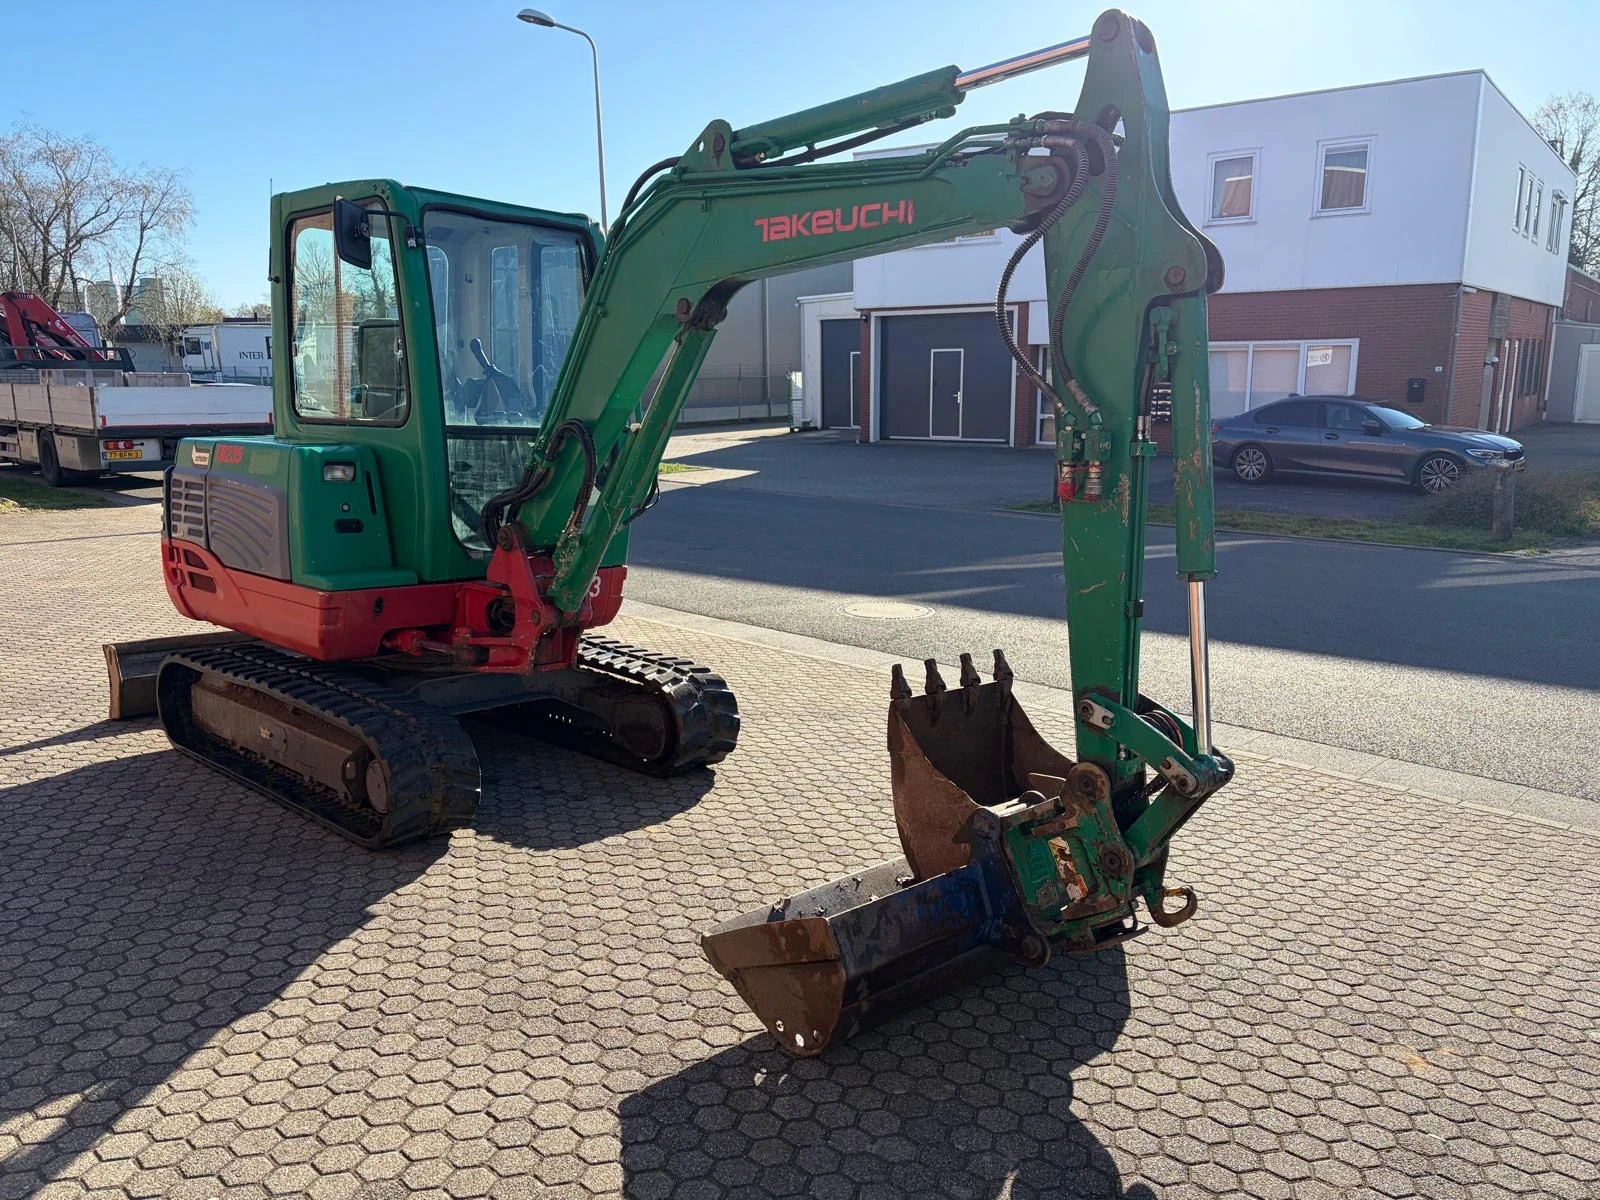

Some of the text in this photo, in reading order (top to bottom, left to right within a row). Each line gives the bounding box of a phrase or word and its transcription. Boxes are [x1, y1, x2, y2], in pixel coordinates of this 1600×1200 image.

[754, 198, 914, 243] TAKEUCHI
[239, 351, 265, 360] INTER
[590, 576, 602, 597] 3
